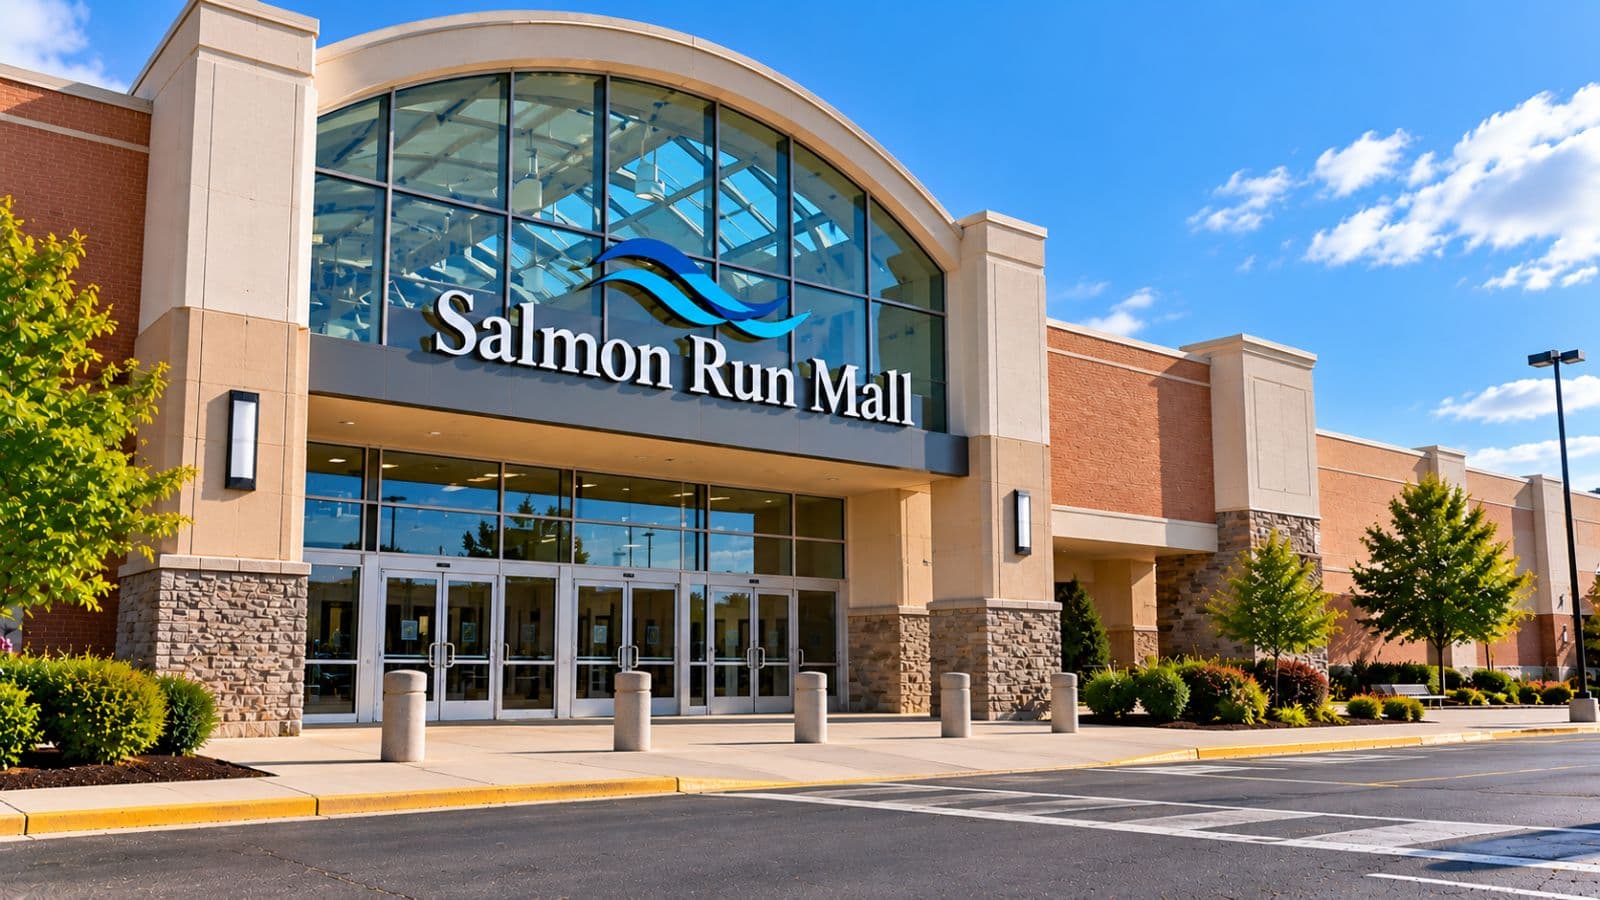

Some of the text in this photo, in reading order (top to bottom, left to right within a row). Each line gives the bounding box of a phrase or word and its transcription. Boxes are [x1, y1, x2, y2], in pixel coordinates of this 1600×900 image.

[435, 289, 915, 426] Salmon Run Mall
